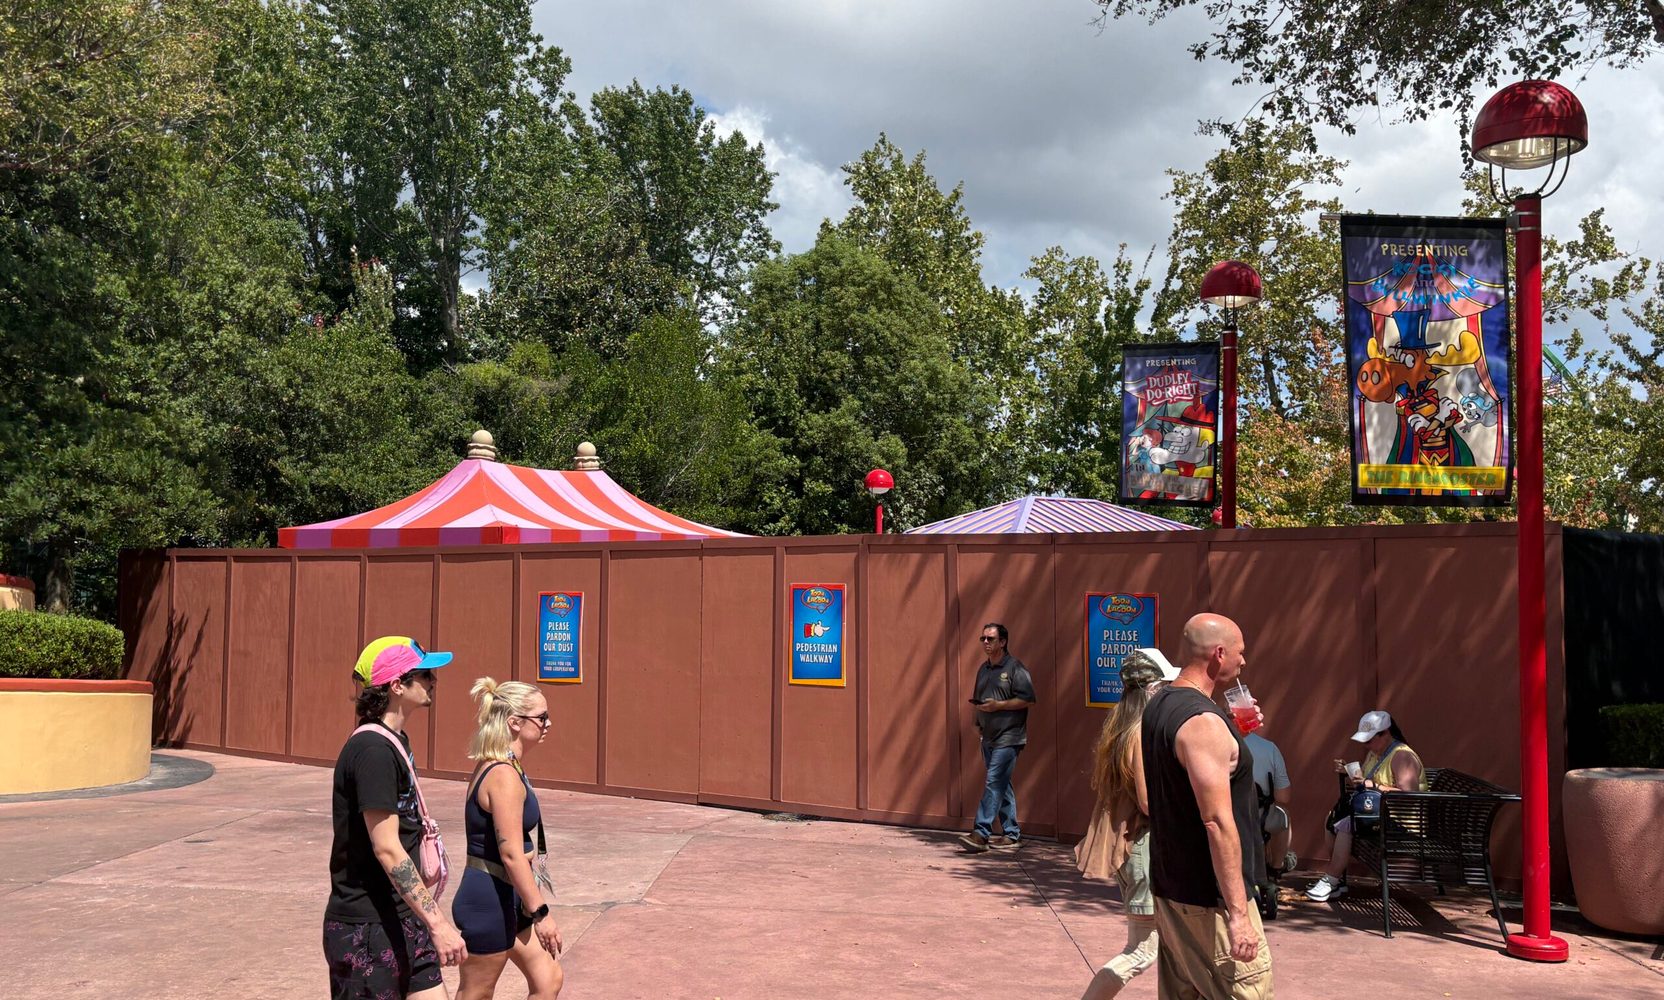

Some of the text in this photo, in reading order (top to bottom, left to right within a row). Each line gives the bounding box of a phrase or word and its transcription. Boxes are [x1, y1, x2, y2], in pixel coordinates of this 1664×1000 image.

[1380, 244, 1468, 257] PRESENTING
[1392, 261, 1456, 277] ROCKY
[1372, 276, 1480, 305] BULLWINKLE
[1145, 358, 1196, 367] PRESENTING
[1148, 372, 1189, 388] DUDLEY
[1146, 383, 1198, 401] DO-RIGHT
[548, 622, 569, 631] PLEASE
[546, 632, 570, 641] PARDON
[1104, 630, 1138, 641] PLEASE
[544, 643, 573, 652] OUR DUST
[796, 643, 837, 653] PEDESTRIAN
[800, 654, 833, 663] WALKWAY
[1097, 657, 1116, 667] OUR
